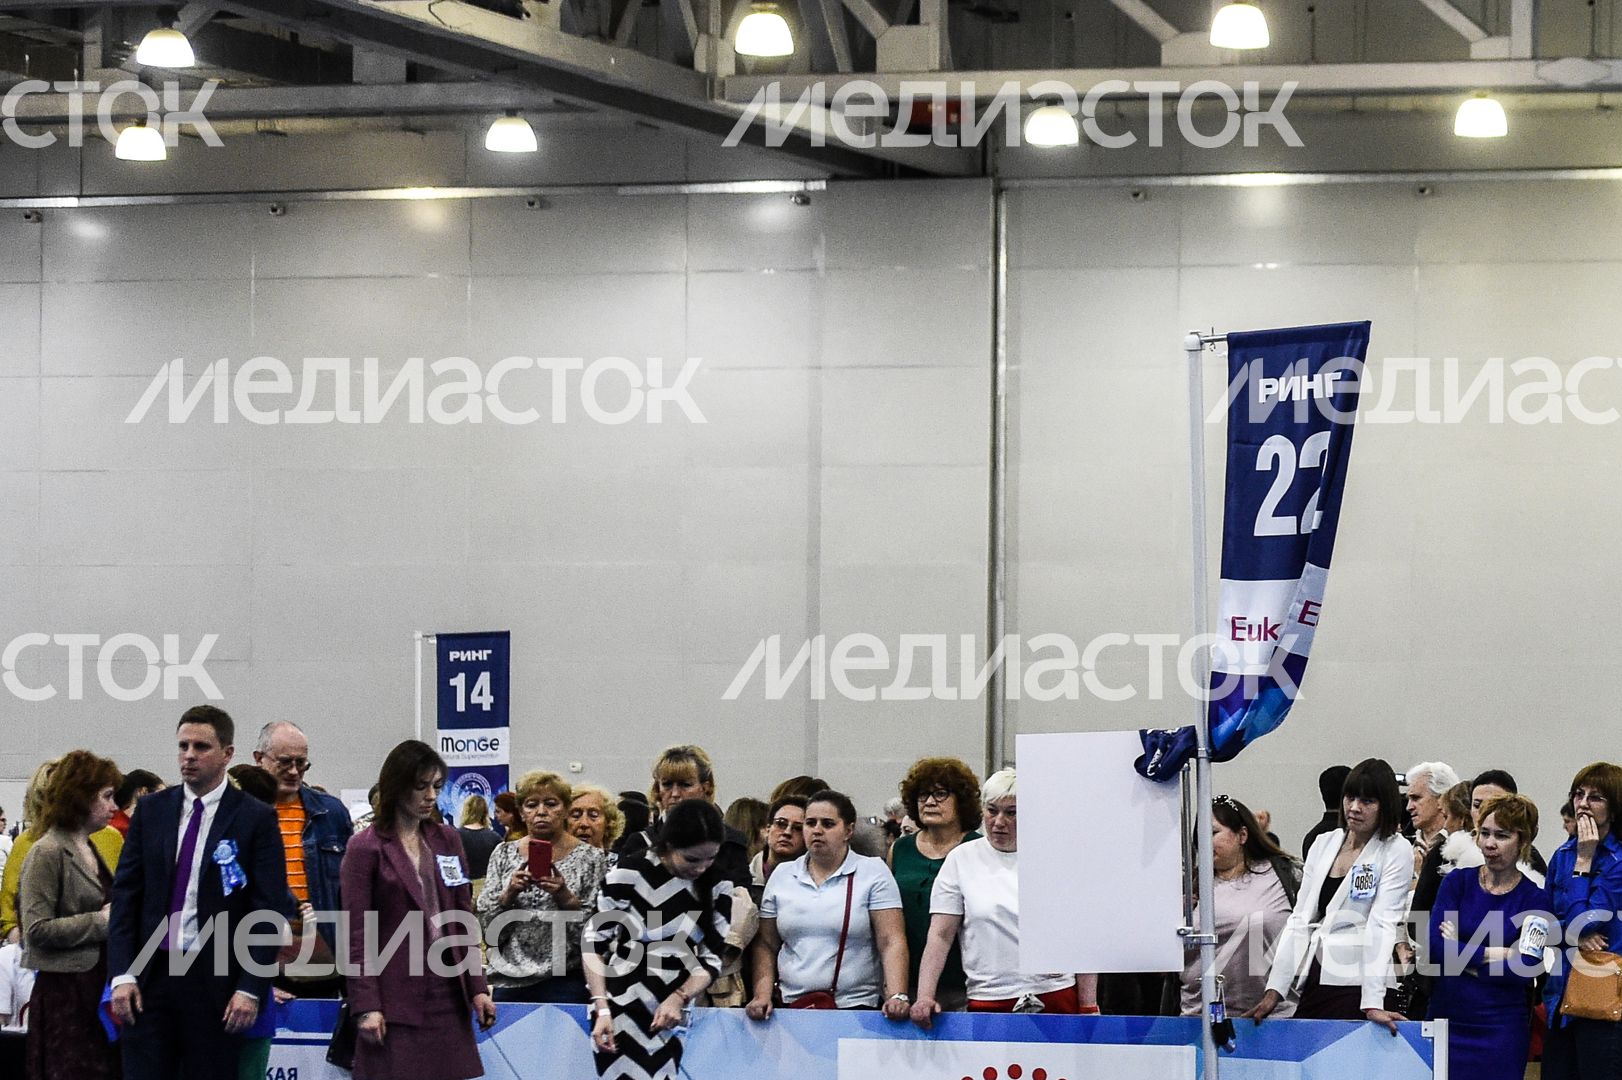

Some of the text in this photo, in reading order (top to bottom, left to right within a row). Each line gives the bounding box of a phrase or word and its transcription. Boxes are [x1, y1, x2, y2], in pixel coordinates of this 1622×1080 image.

[1258, 372, 1342, 403] РИНГ
[449, 649, 493, 662] РИНГ
[449, 671, 494, 712] 14
